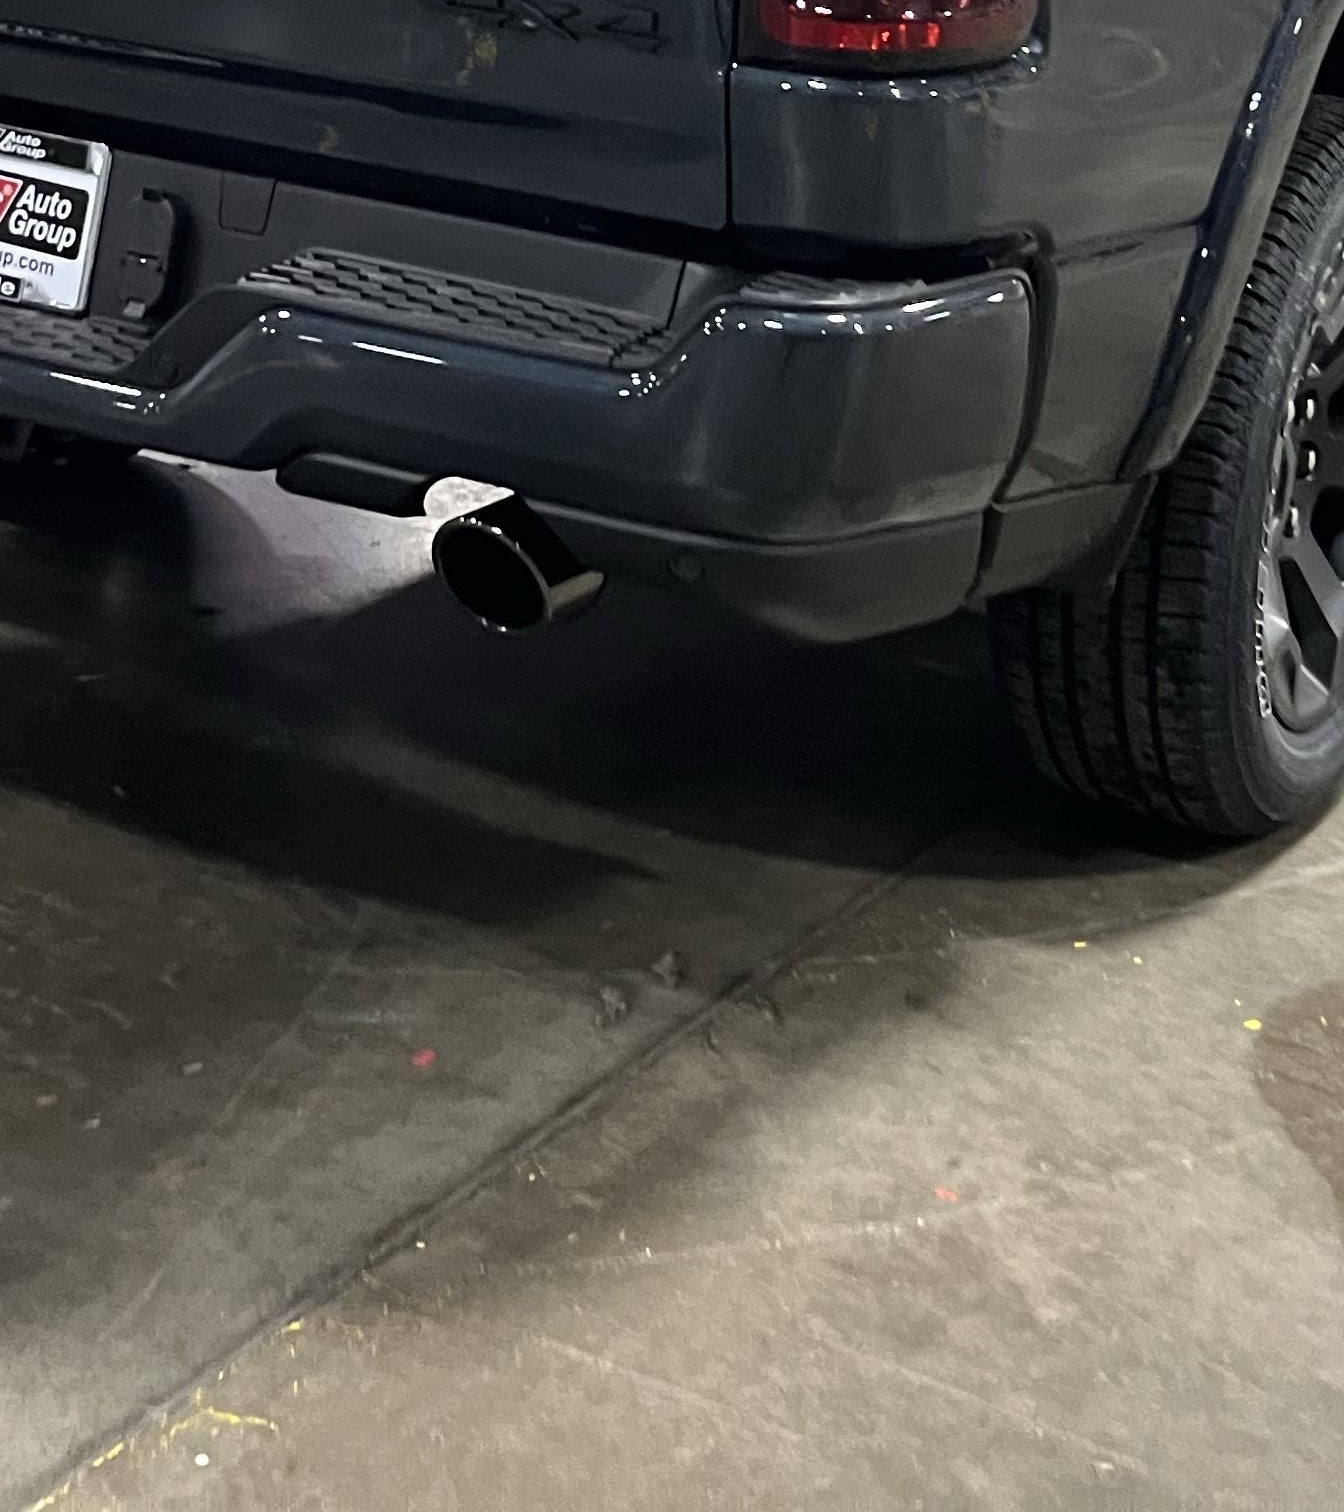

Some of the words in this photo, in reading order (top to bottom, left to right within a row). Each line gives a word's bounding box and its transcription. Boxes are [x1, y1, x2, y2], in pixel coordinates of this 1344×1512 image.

[0, 140, 47, 160] Group
[1, 130, 42, 148] Auto
[16, 183, 73, 221] Auto
[8, 211, 77, 252] Group
